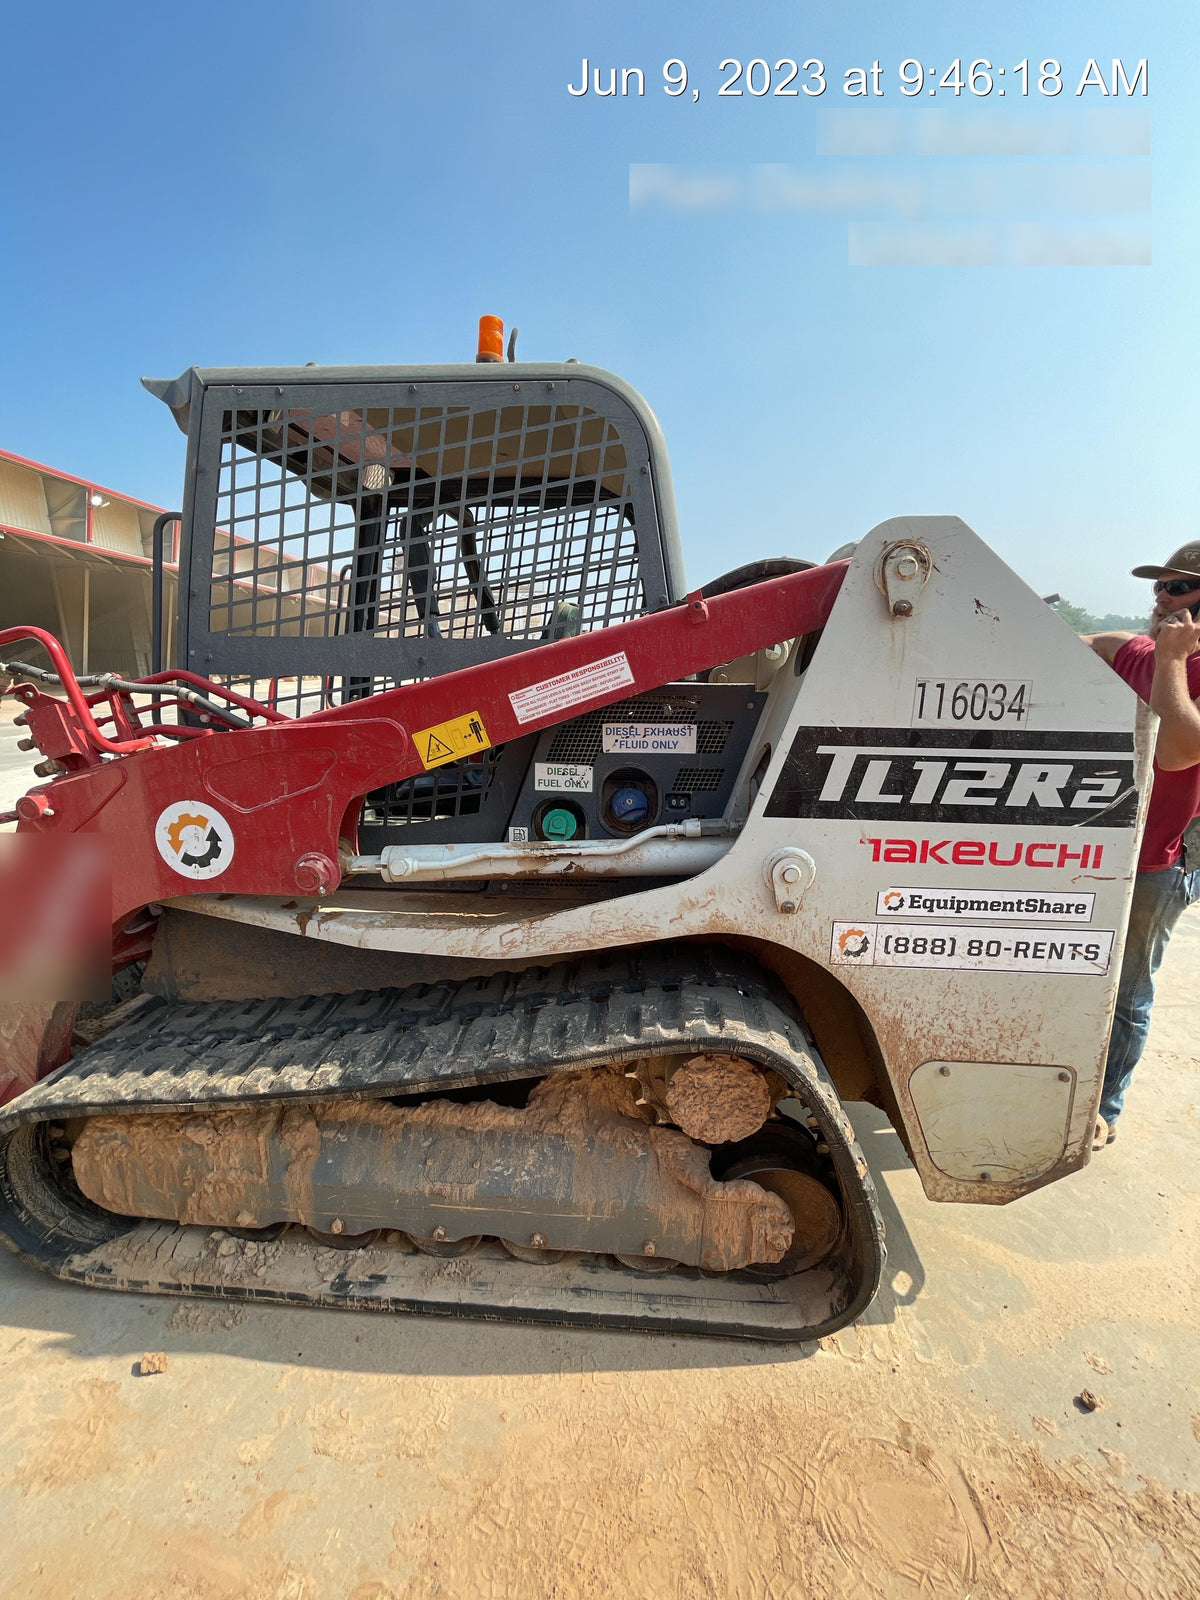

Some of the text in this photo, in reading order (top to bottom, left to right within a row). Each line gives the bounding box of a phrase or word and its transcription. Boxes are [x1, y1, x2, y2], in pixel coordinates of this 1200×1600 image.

[535, 655, 625, 691] CUSTOMER RESPONSIBILITY
[917, 682, 1026, 721] 116034
[605, 726, 694, 737] DIESEL EXHAUST
[619, 740, 679, 749] FLUID ONLY
[547, 767, 579, 776] DIESEL
[537, 779, 590, 789] FUEL ONLY
[908, 894, 1088, 915] EquipmentShare
[884, 935, 1100, 961] (888) 80-RENTS
